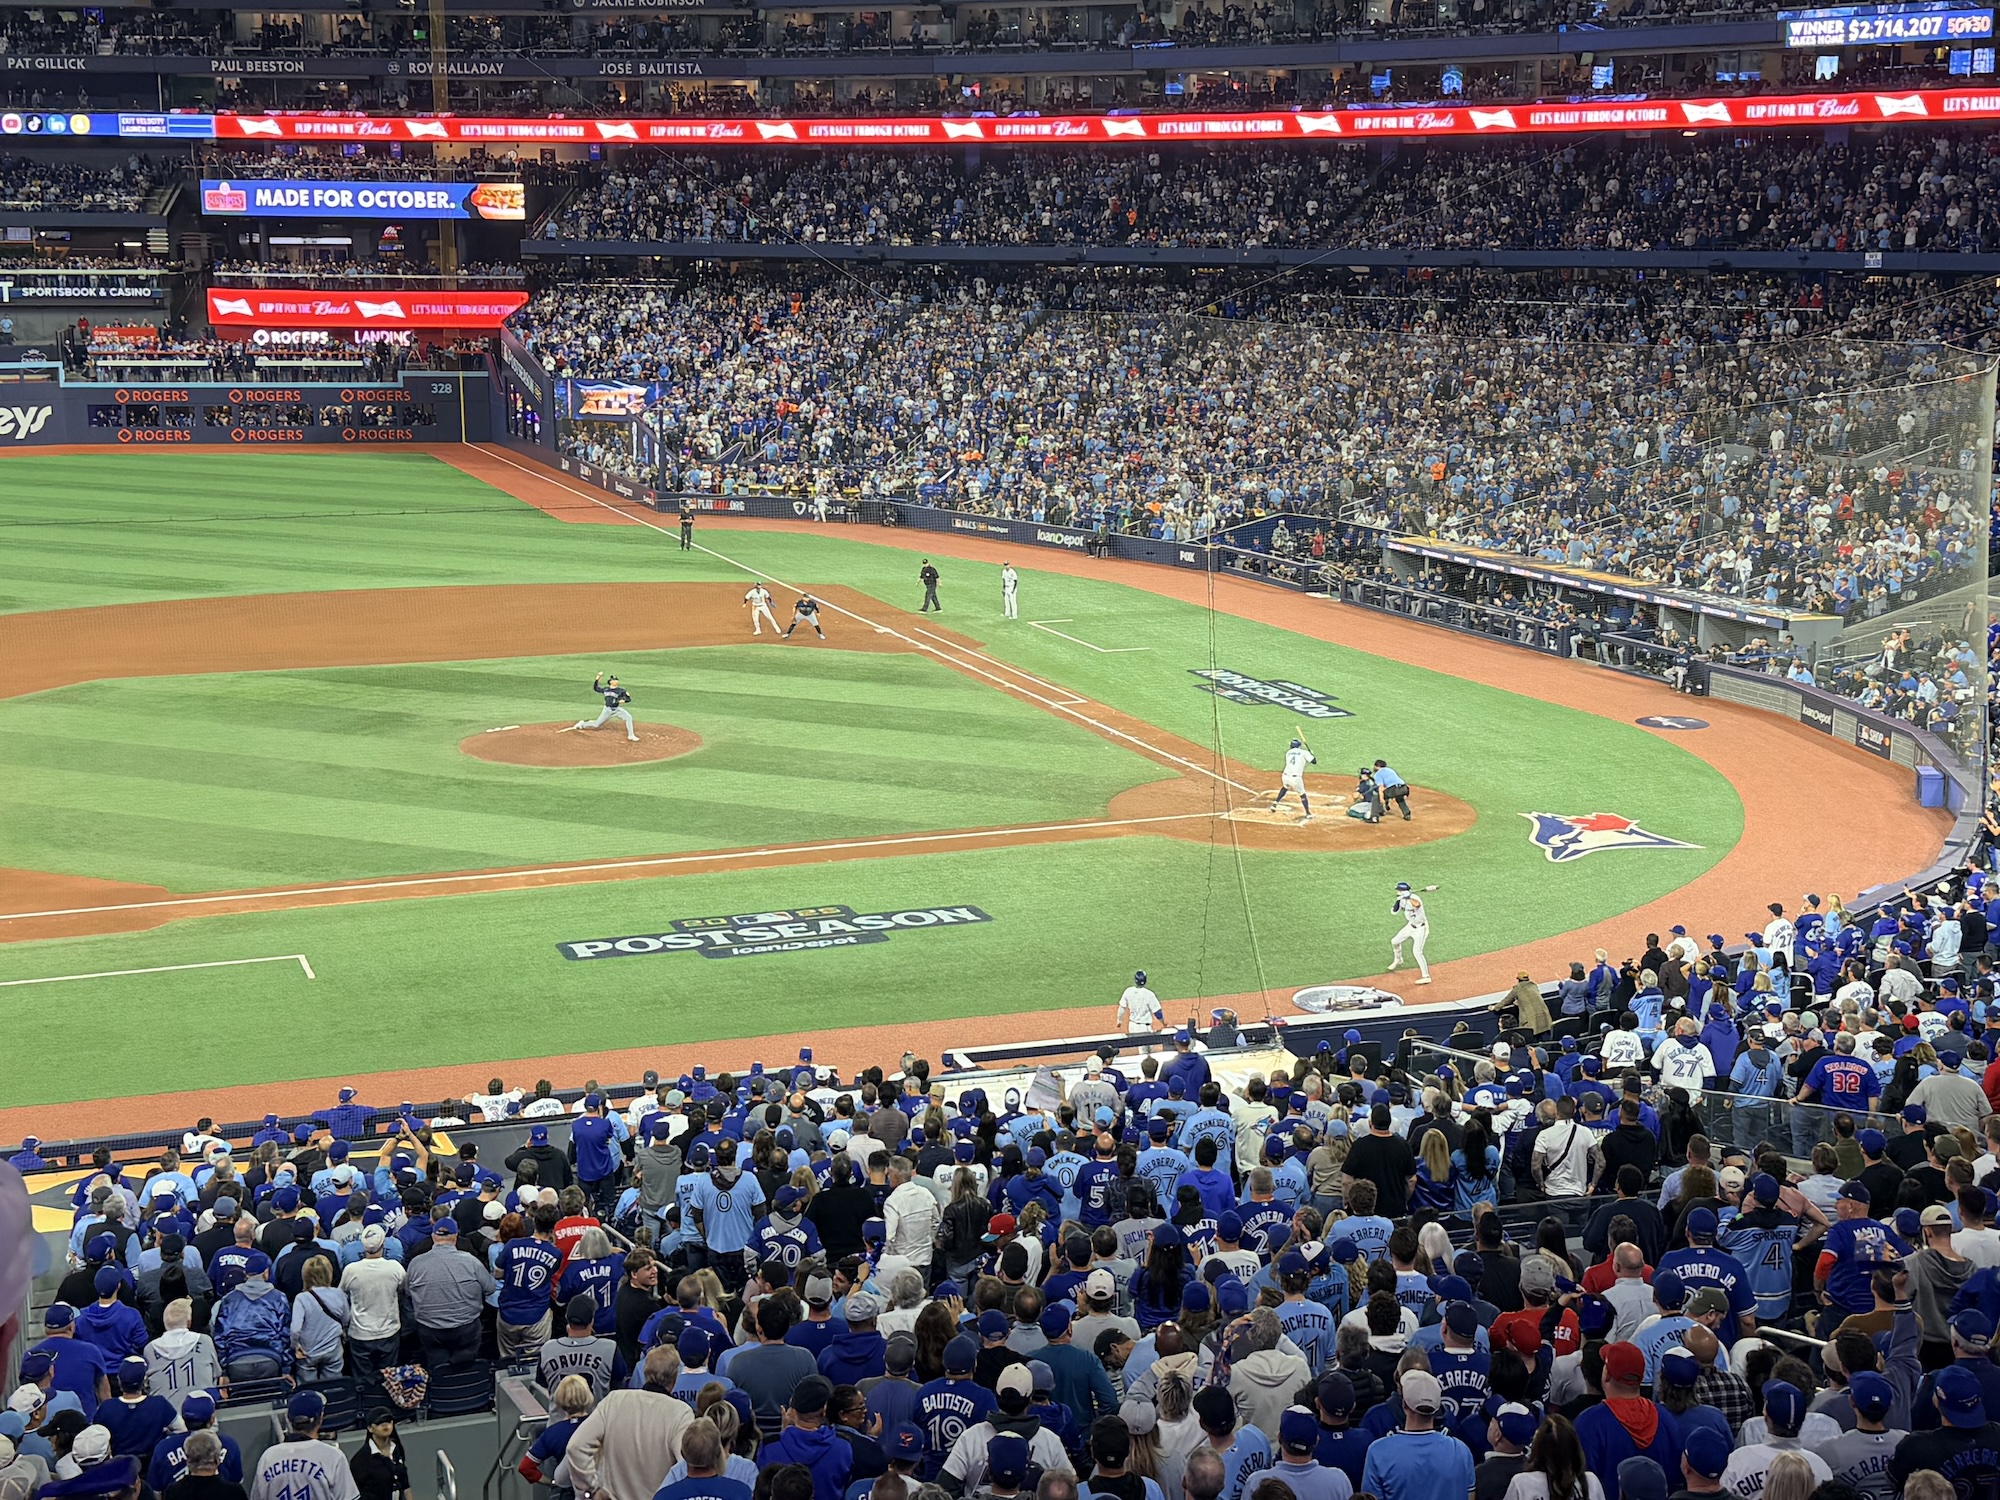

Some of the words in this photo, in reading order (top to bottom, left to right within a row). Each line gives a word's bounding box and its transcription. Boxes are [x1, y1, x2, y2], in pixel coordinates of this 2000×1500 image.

[1789, 20, 1844, 36] WINNER
[1849, 17, 1943, 42] $2,714,207
[1789, 35, 1817, 47] TAKES
[1817, 33, 1845, 45] HOME
[8, 58, 32, 70] PAT
[35, 58, 86, 71] GILLICK
[211, 60, 243, 71] PAUL
[246, 61, 304, 72] BEESTON
[409, 63, 434, 73] ROY
[438, 62, 504, 74] HALLADAY
[599, 60, 632, 75] JOSÉ
[639, 63, 703, 75] BAUTISTA
[1746, 105, 1766, 118] FLIP
[1778, 104, 1796, 116] FOR
[1798, 103, 1815, 115] THE
[1816, 99, 1859, 117] Buds
[1943, 97, 1969, 112] LET'S
[1530, 112, 1552, 124] LET'S
[1553, 111, 1580, 123] RALLY
[1581, 110, 1624, 122] THROUGH
[1626, 109, 1667, 121] OCTOBER
[256, 189, 309, 206] MADE
[314, 190, 354, 206] FOR
[358, 191, 456, 209] OCTOBER.
[22, 287, 97, 297] SPORTSBOOK
[99, 287, 106, 297] &
[109, 287, 151, 297] CASINO
[411, 304, 431, 315] LET'S
[431, 304, 453, 315] RALLY
[271, 330, 329, 345] ROGERS
[132, 390, 189, 402] ROGERS
[246, 390, 301, 402] ROGERS
[357, 390, 411, 401] ROGERS
[431, 383, 453, 394] 328
[135, 430, 191, 441] ROGERS
[248, 429, 303, 441] ROGERS
[359, 429, 413, 440] ROGERS
[1037, 529, 1085, 547] loanDepot
[1180, 551, 1195, 563] FOX
[1802, 704, 1832, 726] loanDepot
[567, 906, 982, 958] POSTSEASON
[732, 935, 858, 956] loanDepot
[1672, 1059, 1698, 1078] 27
[1755, 1069, 1769, 1085] 4
[1832, 1072, 1860, 1093] 32
[1139, 1156, 1174, 1177] GUERRERO
[1058, 1166, 1074, 1188] 0
[1151, 1173, 1178, 1200] 27
[716, 1190, 732, 1213] 0
[1088, 1185, 1106, 1209] 5
[1242, 1210, 1284, 1235] GUERRERO
[1752, 1229, 1793, 1243] SPRINGER
[512, 1247, 558, 1269] BAUTISTA
[765, 1240, 801, 1268] 20
[1761, 1242, 1784, 1271] 4
[512, 1262, 547, 1291] 19
[579, 1265, 611, 1282] PILLAR
[1281, 1313, 1329, 1334] BICHETTE
[549, 1353, 602, 1372] DAVIES
[162, 1357, 196, 1390] 11
[922, 1393, 975, 1418] BAUTISTA
[927, 1414, 968, 1452] 19
[263, 1458, 324, 1483] BICHETTE
